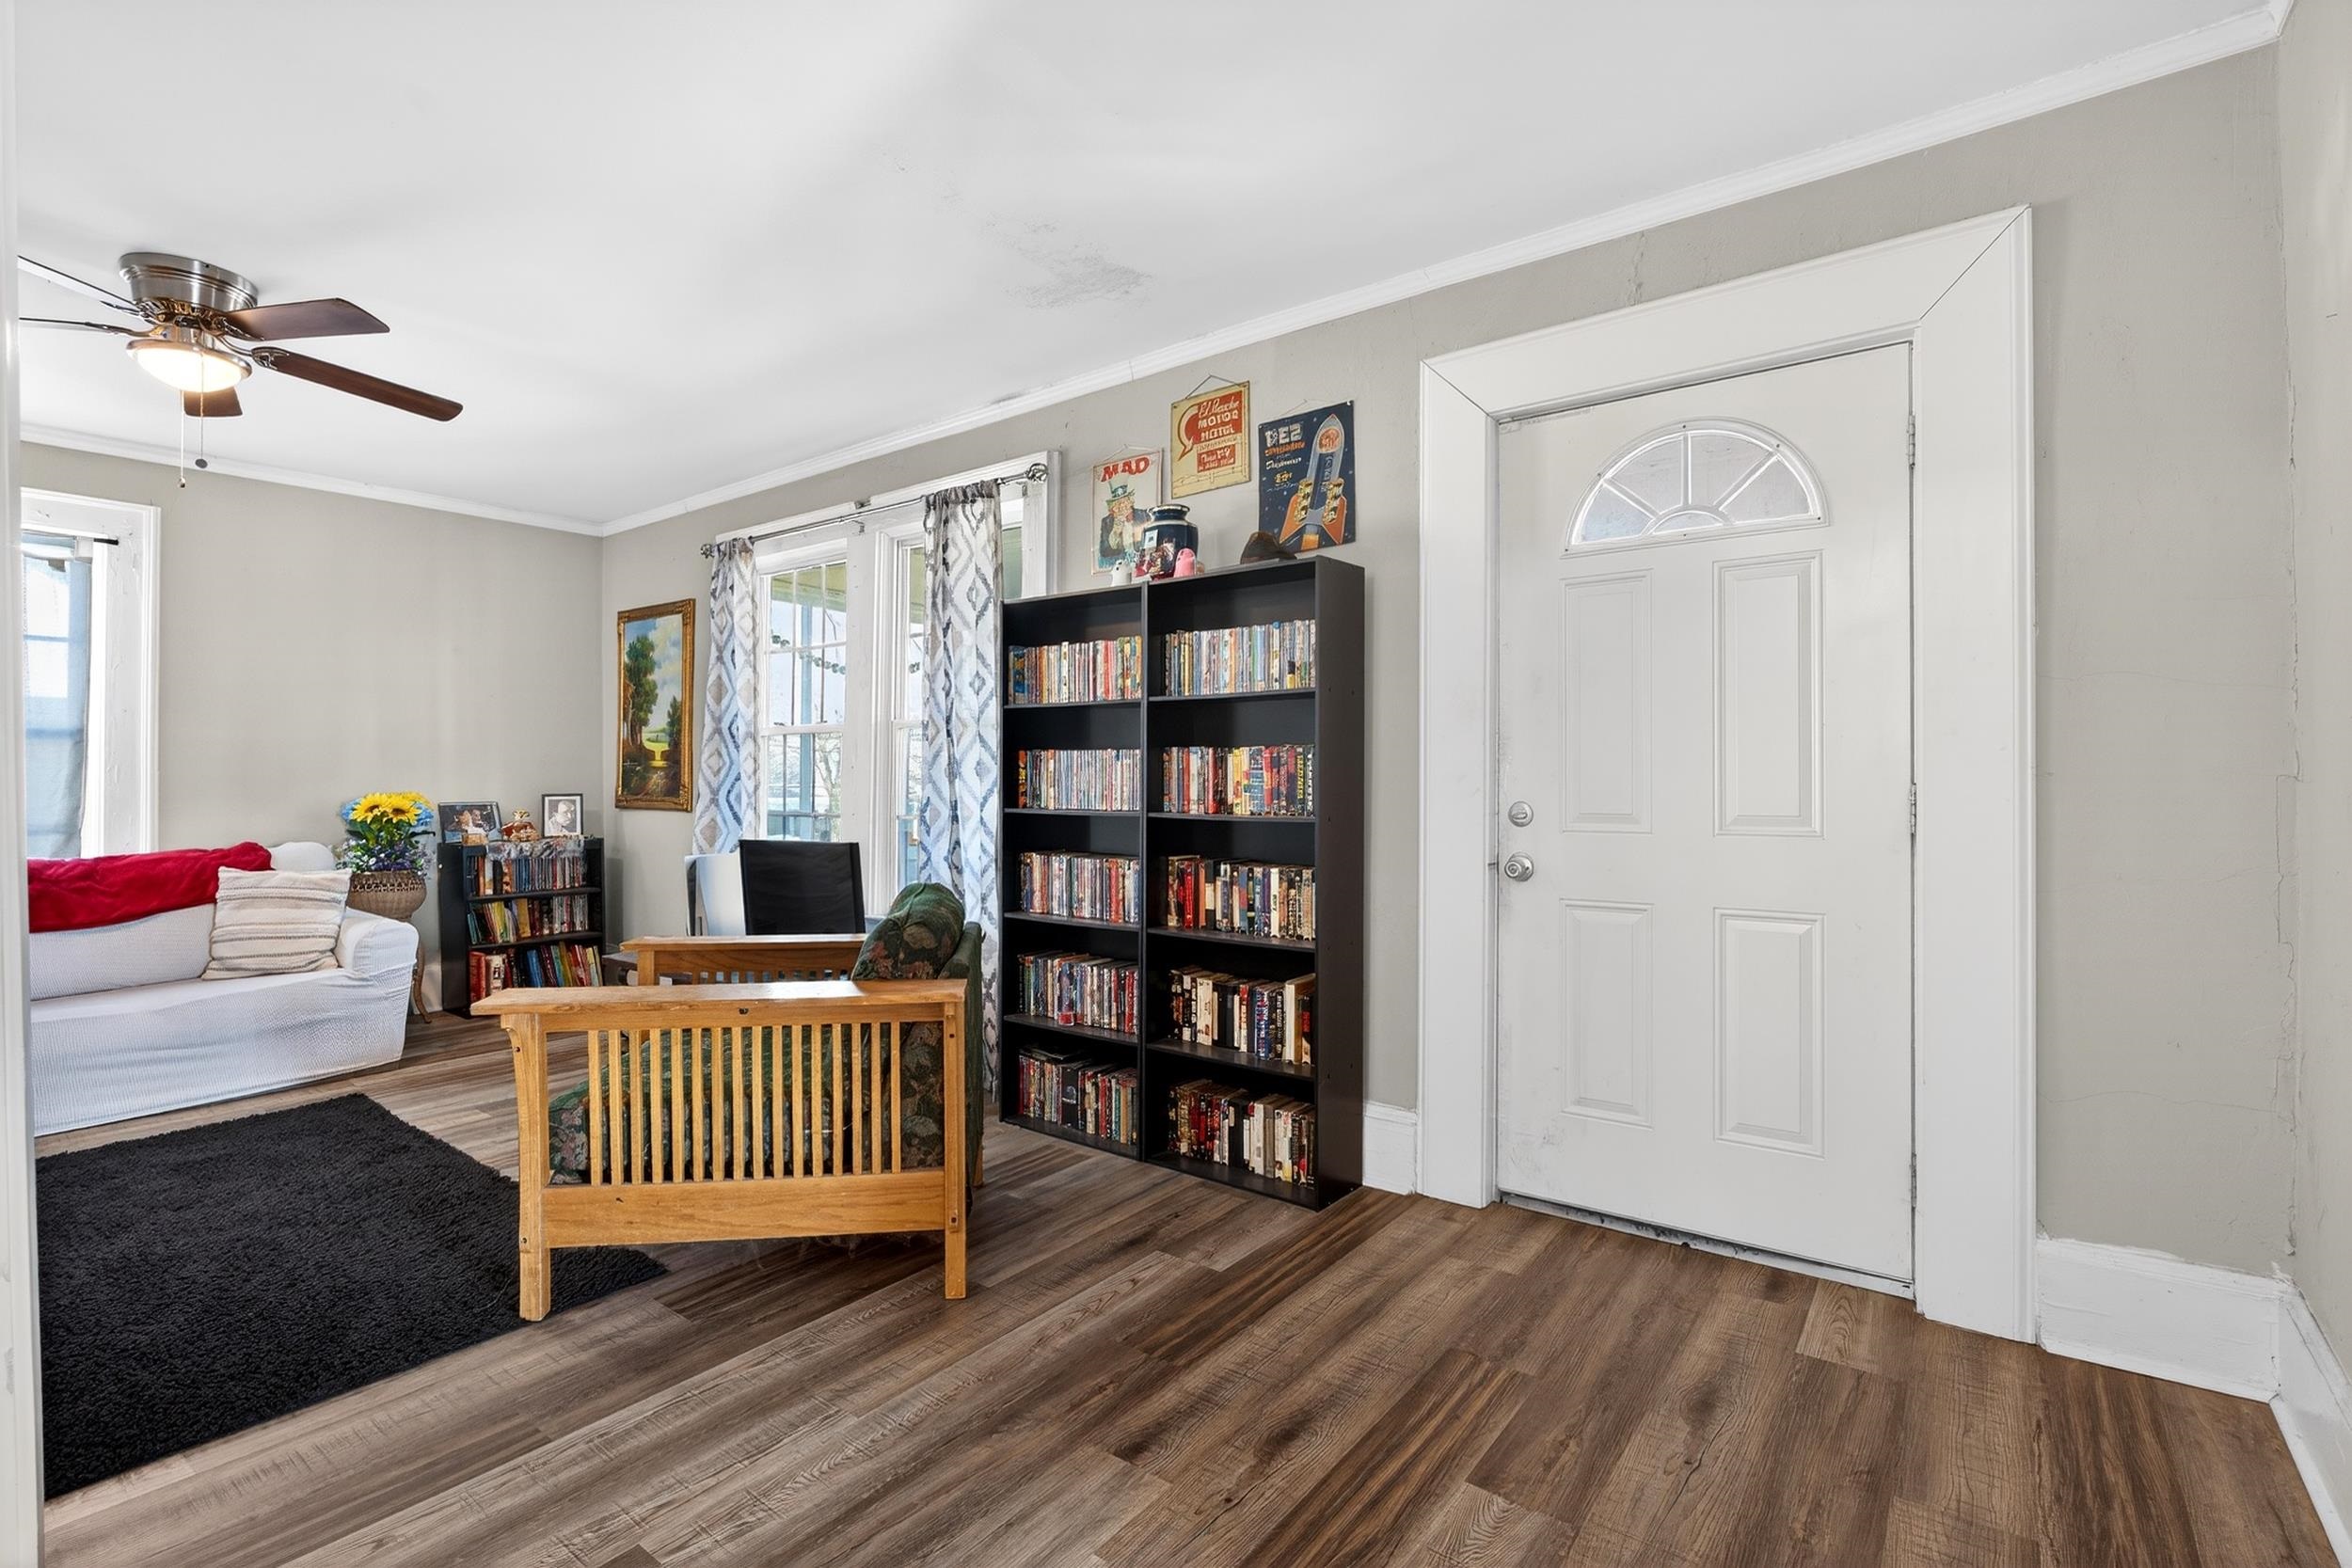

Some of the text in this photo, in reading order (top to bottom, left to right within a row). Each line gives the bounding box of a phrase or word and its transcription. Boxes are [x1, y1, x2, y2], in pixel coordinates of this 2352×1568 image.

[1198, 410, 1239, 429] MOTOR
[1265, 422, 1302, 447] PEZ
[1101, 456, 1150, 482] MAD
